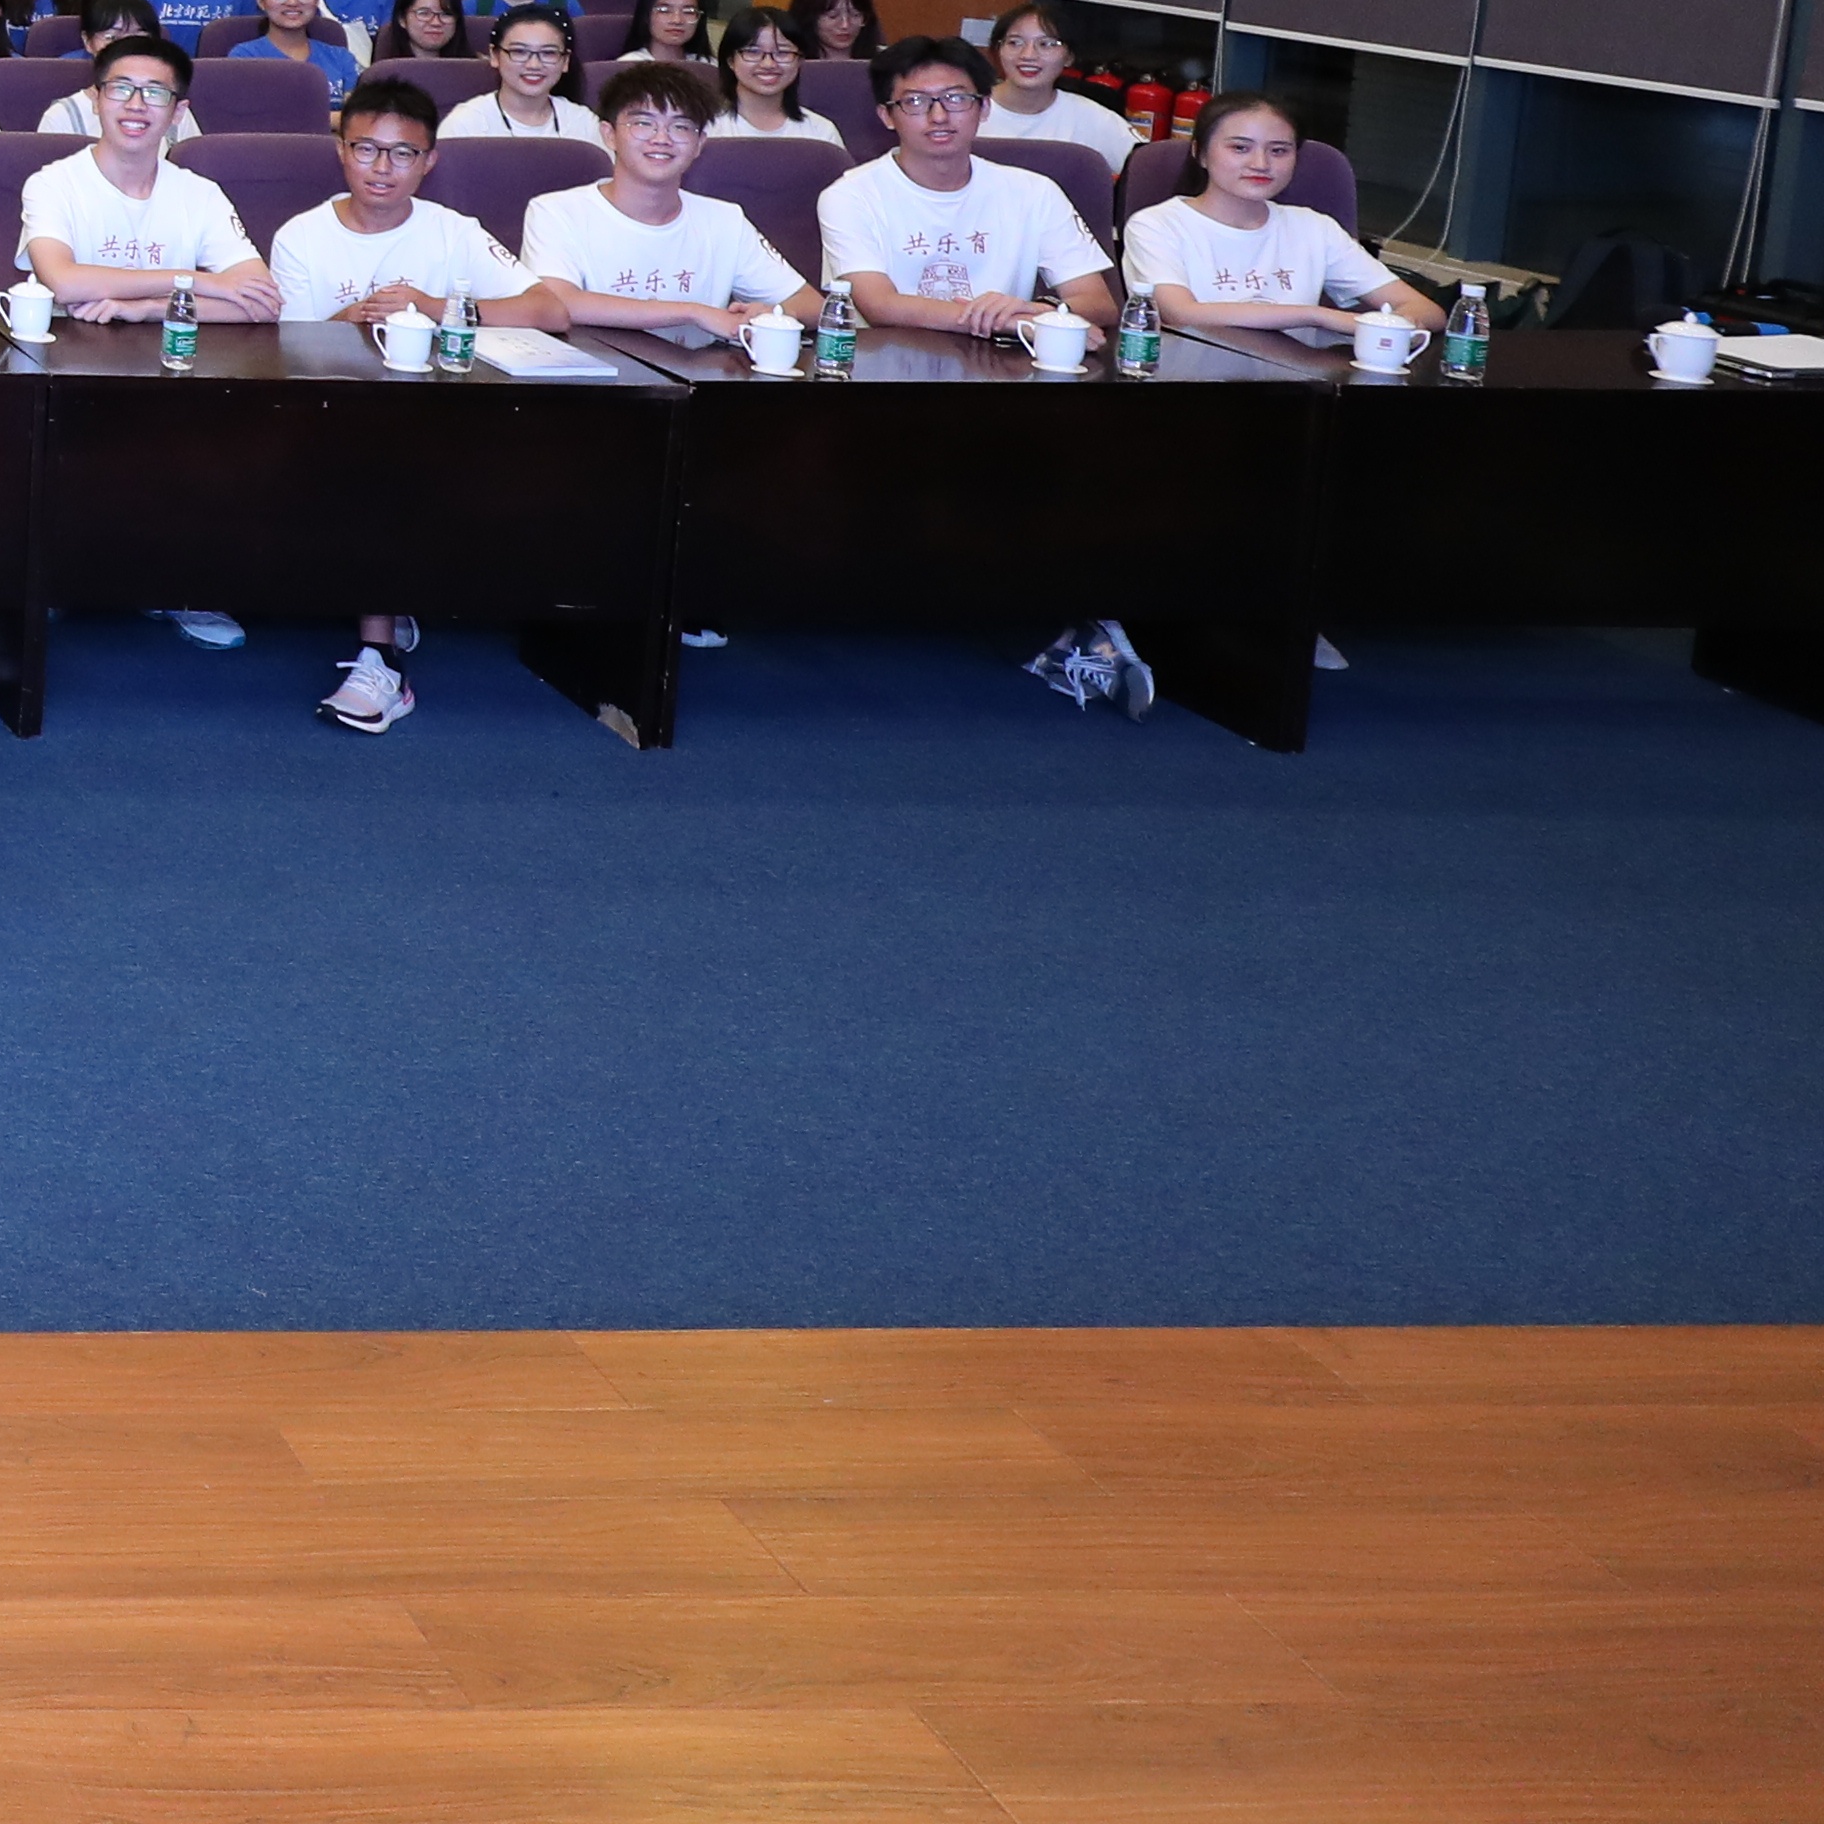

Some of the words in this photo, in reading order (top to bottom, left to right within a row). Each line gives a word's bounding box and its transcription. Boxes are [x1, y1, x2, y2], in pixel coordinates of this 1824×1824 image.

[98, 235, 166, 265] 共乐育
[903, 231, 989, 255] 共乐育
[611, 268, 695, 294] 共乐育
[1212, 268, 1295, 292] 共乐育
